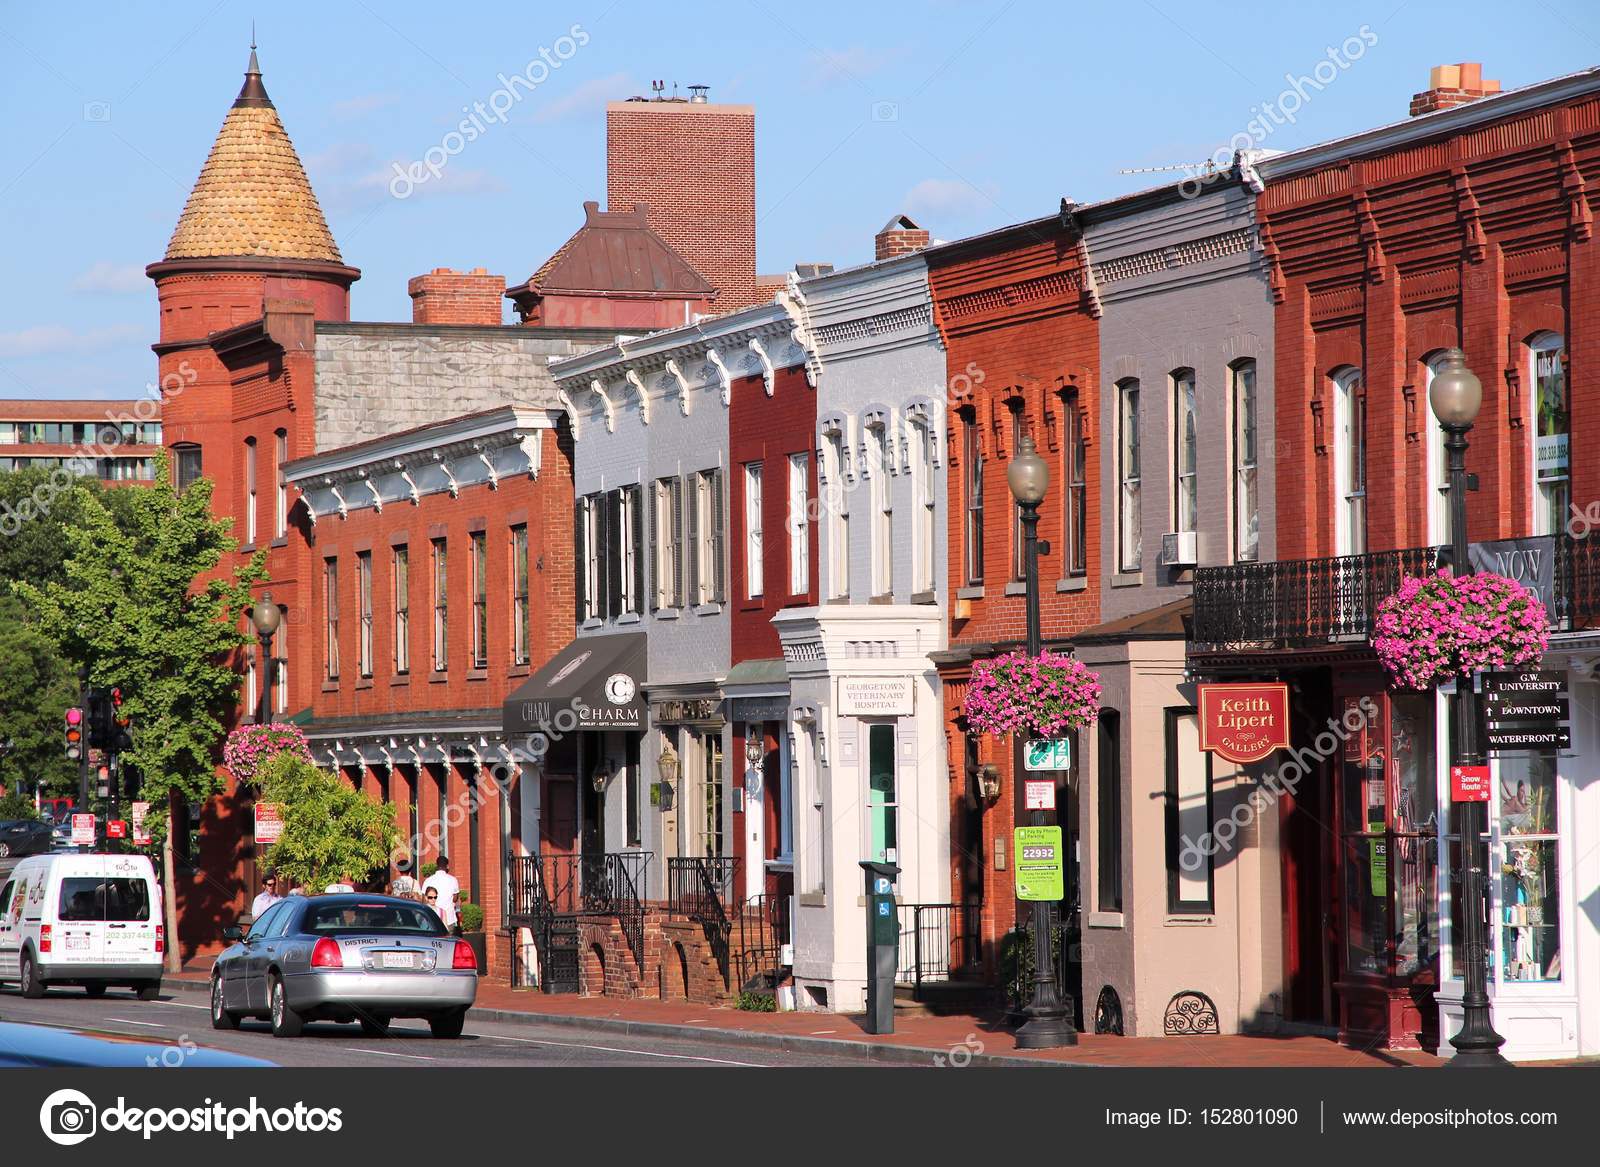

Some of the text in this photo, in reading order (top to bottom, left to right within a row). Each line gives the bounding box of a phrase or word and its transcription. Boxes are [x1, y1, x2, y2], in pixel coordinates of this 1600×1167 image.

[1496, 549, 1541, 581] NOW
[1520, 674, 1540, 682] G.W.
[1500, 682, 1561, 692] UNIVERSITY
[1220, 698, 1271, 712] Keith
[1502, 706, 1561, 715] DOWNTOWN
[522, 702, 550, 721] CHARM
[580, 708, 639, 720] CHARM
[1217, 713, 1274, 730] Lipert
[1222, 734, 1271, 752] GALLERY
[1488, 734, 1557, 744] WATERFRONT
[1461, 775, 1480, 783] Snow
[1023, 849, 1054, 858] 22932
